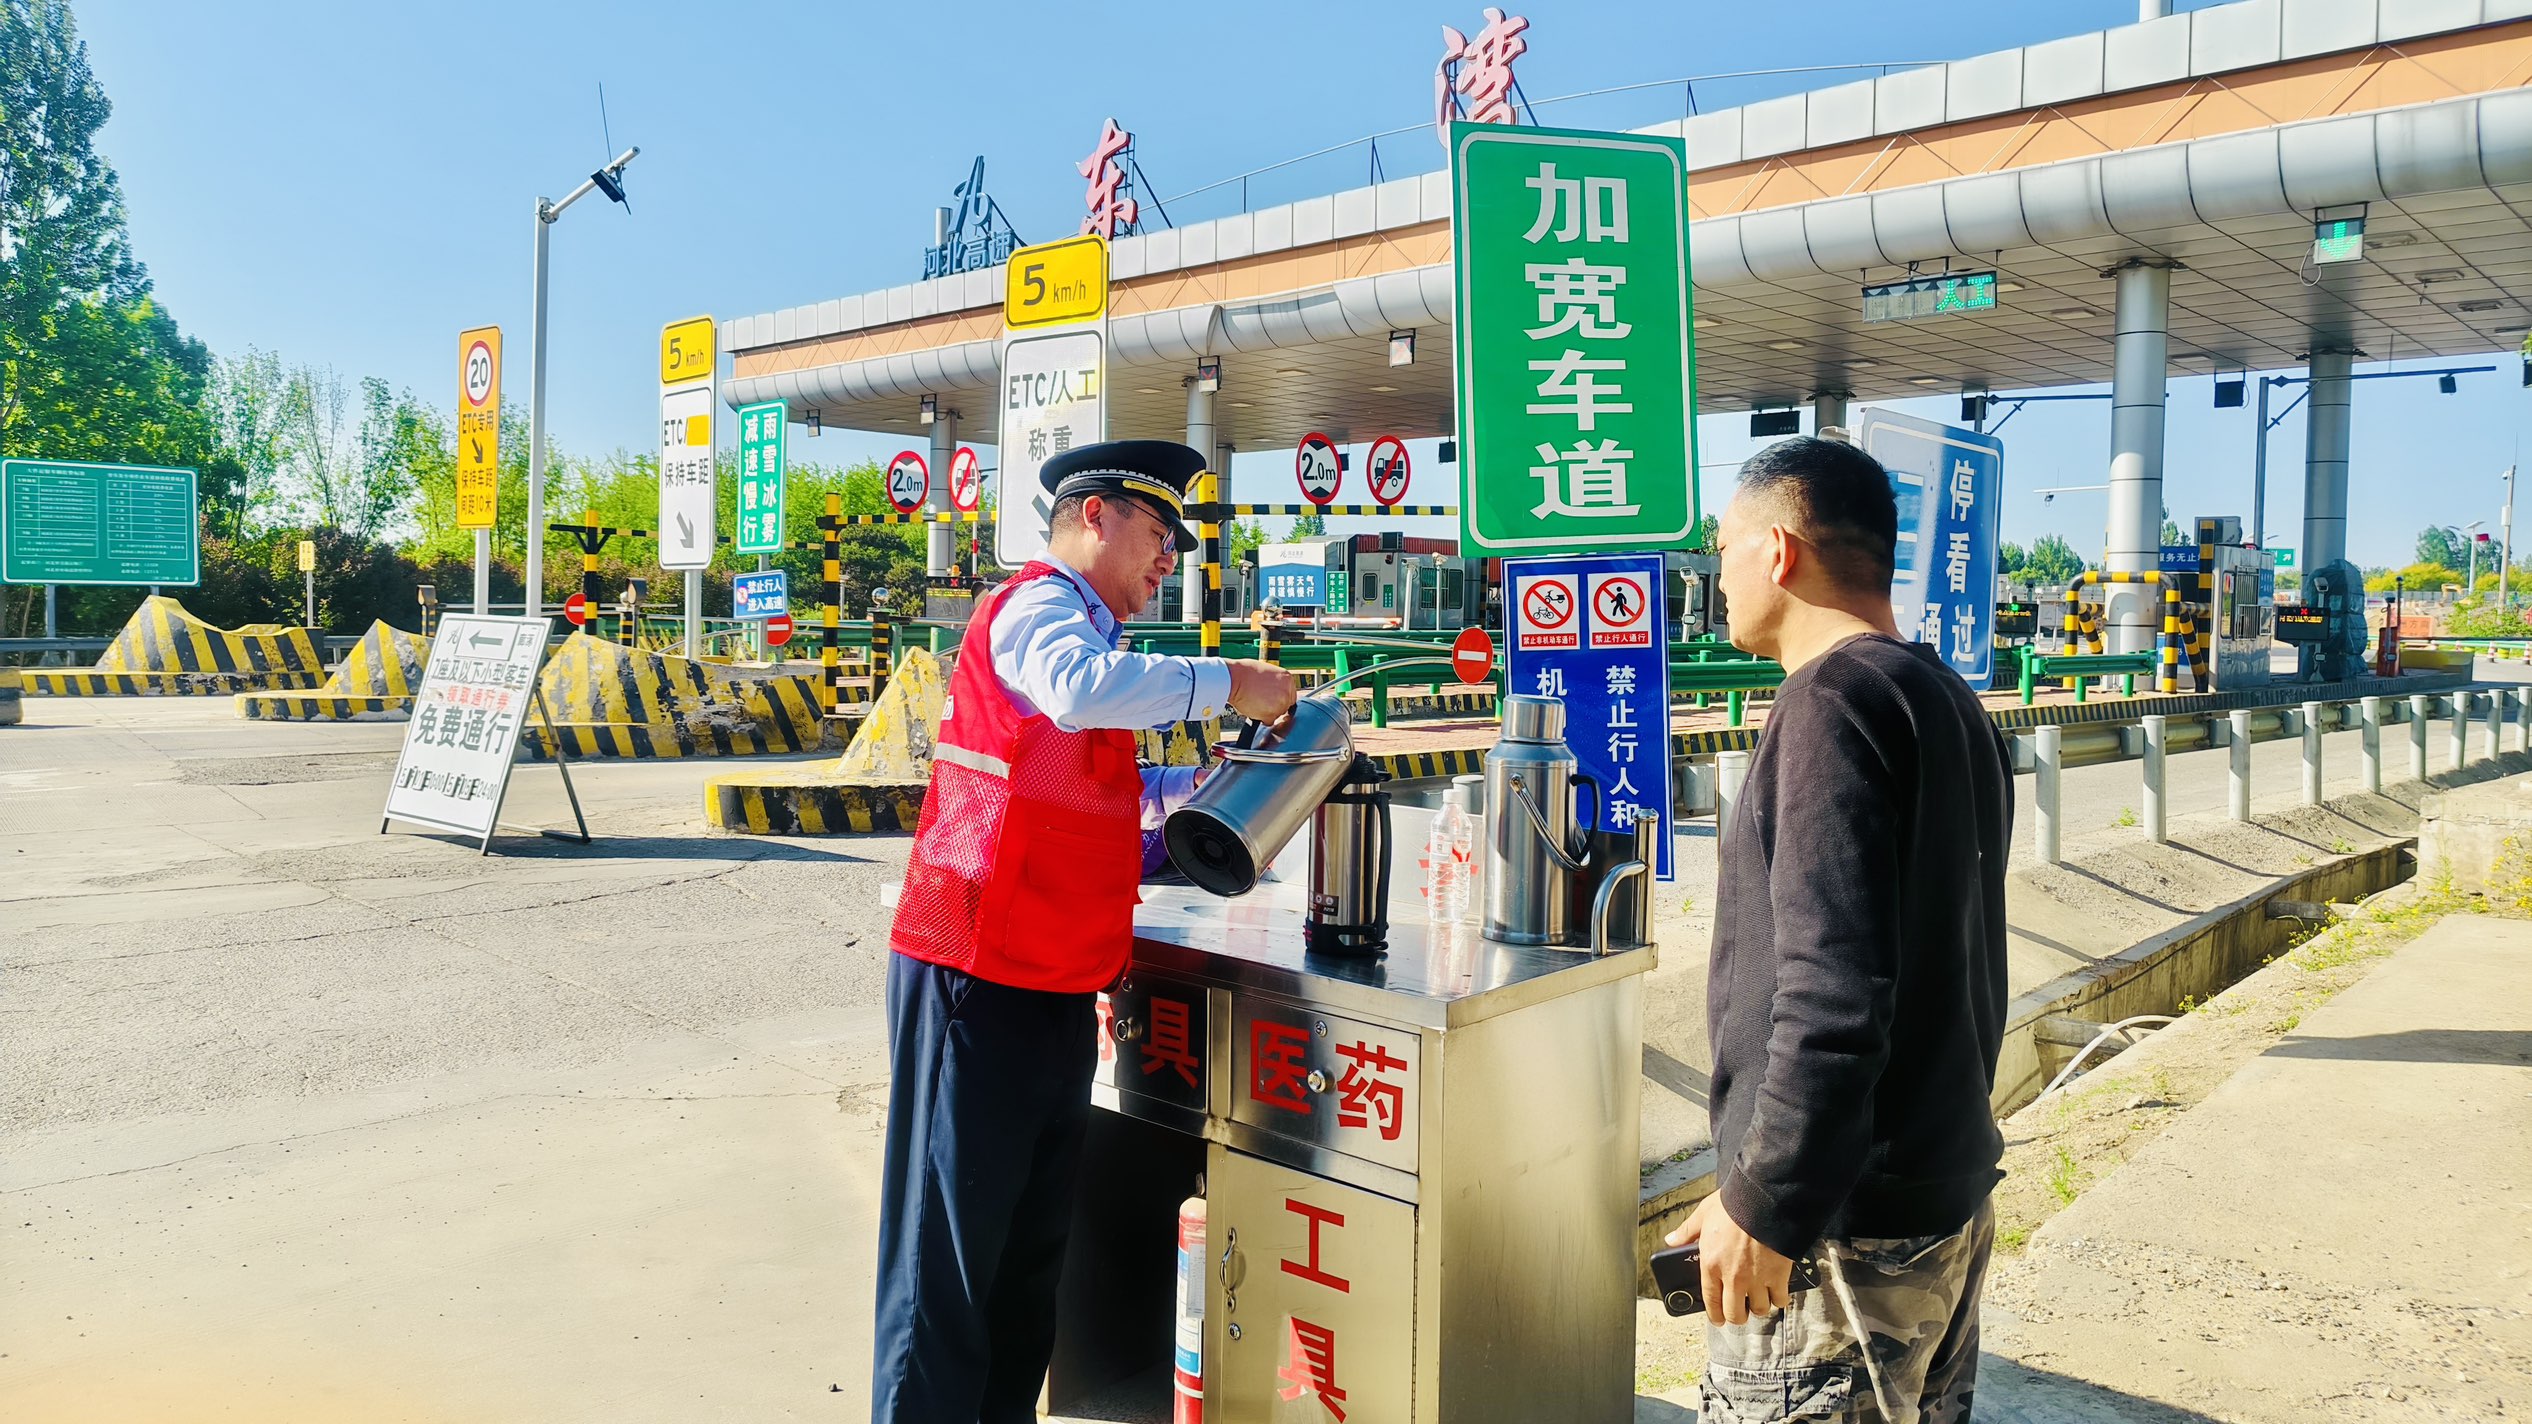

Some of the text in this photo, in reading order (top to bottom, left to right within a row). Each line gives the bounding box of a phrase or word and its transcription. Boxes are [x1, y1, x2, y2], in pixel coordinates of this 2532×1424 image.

[924, 228, 1014, 280] 河北高速
[1022, 263, 1086, 306] 5 km/h
[1936, 274, 1993, 311] 人工
[669, 337, 704, 370] 5 km/h
[1522, 161, 1642, 520] 加宽车道
[470, 356, 489, 389] 20
[1009, 369, 1097, 409] ETC/人工
[462, 409, 494, 435] ETC专用
[1028, 425, 1073, 462] 称重
[461, 467, 493, 490] 保持车距
[665, 458, 709, 488] 保持车距
[743, 413, 759, 544] 减速慢行
[762, 411, 778, 543] 雨雪冰雾
[892, 468, 923, 492] 2.0m
[1301, 452, 1336, 481] 2.0m
[460, 493, 492, 516] 间距10米
[2160, 552, 2200, 562] 务无止
[747, 578, 783, 595] 禁止行人
[1268, 575, 1314, 587] 雨雪雾天气
[747, 595, 783, 612] 进入高速
[1523, 635, 1575, 646] 禁止非机动车通行
[1594, 633, 1647, 643] 禁止行人通行
[414, 703, 512, 755] 免费通行
[1605, 664, 1640, 829] 禁止行人和
[1250, 1018, 1408, 1141] 医药
[1277, 1197, 1350, 1424] 工具
